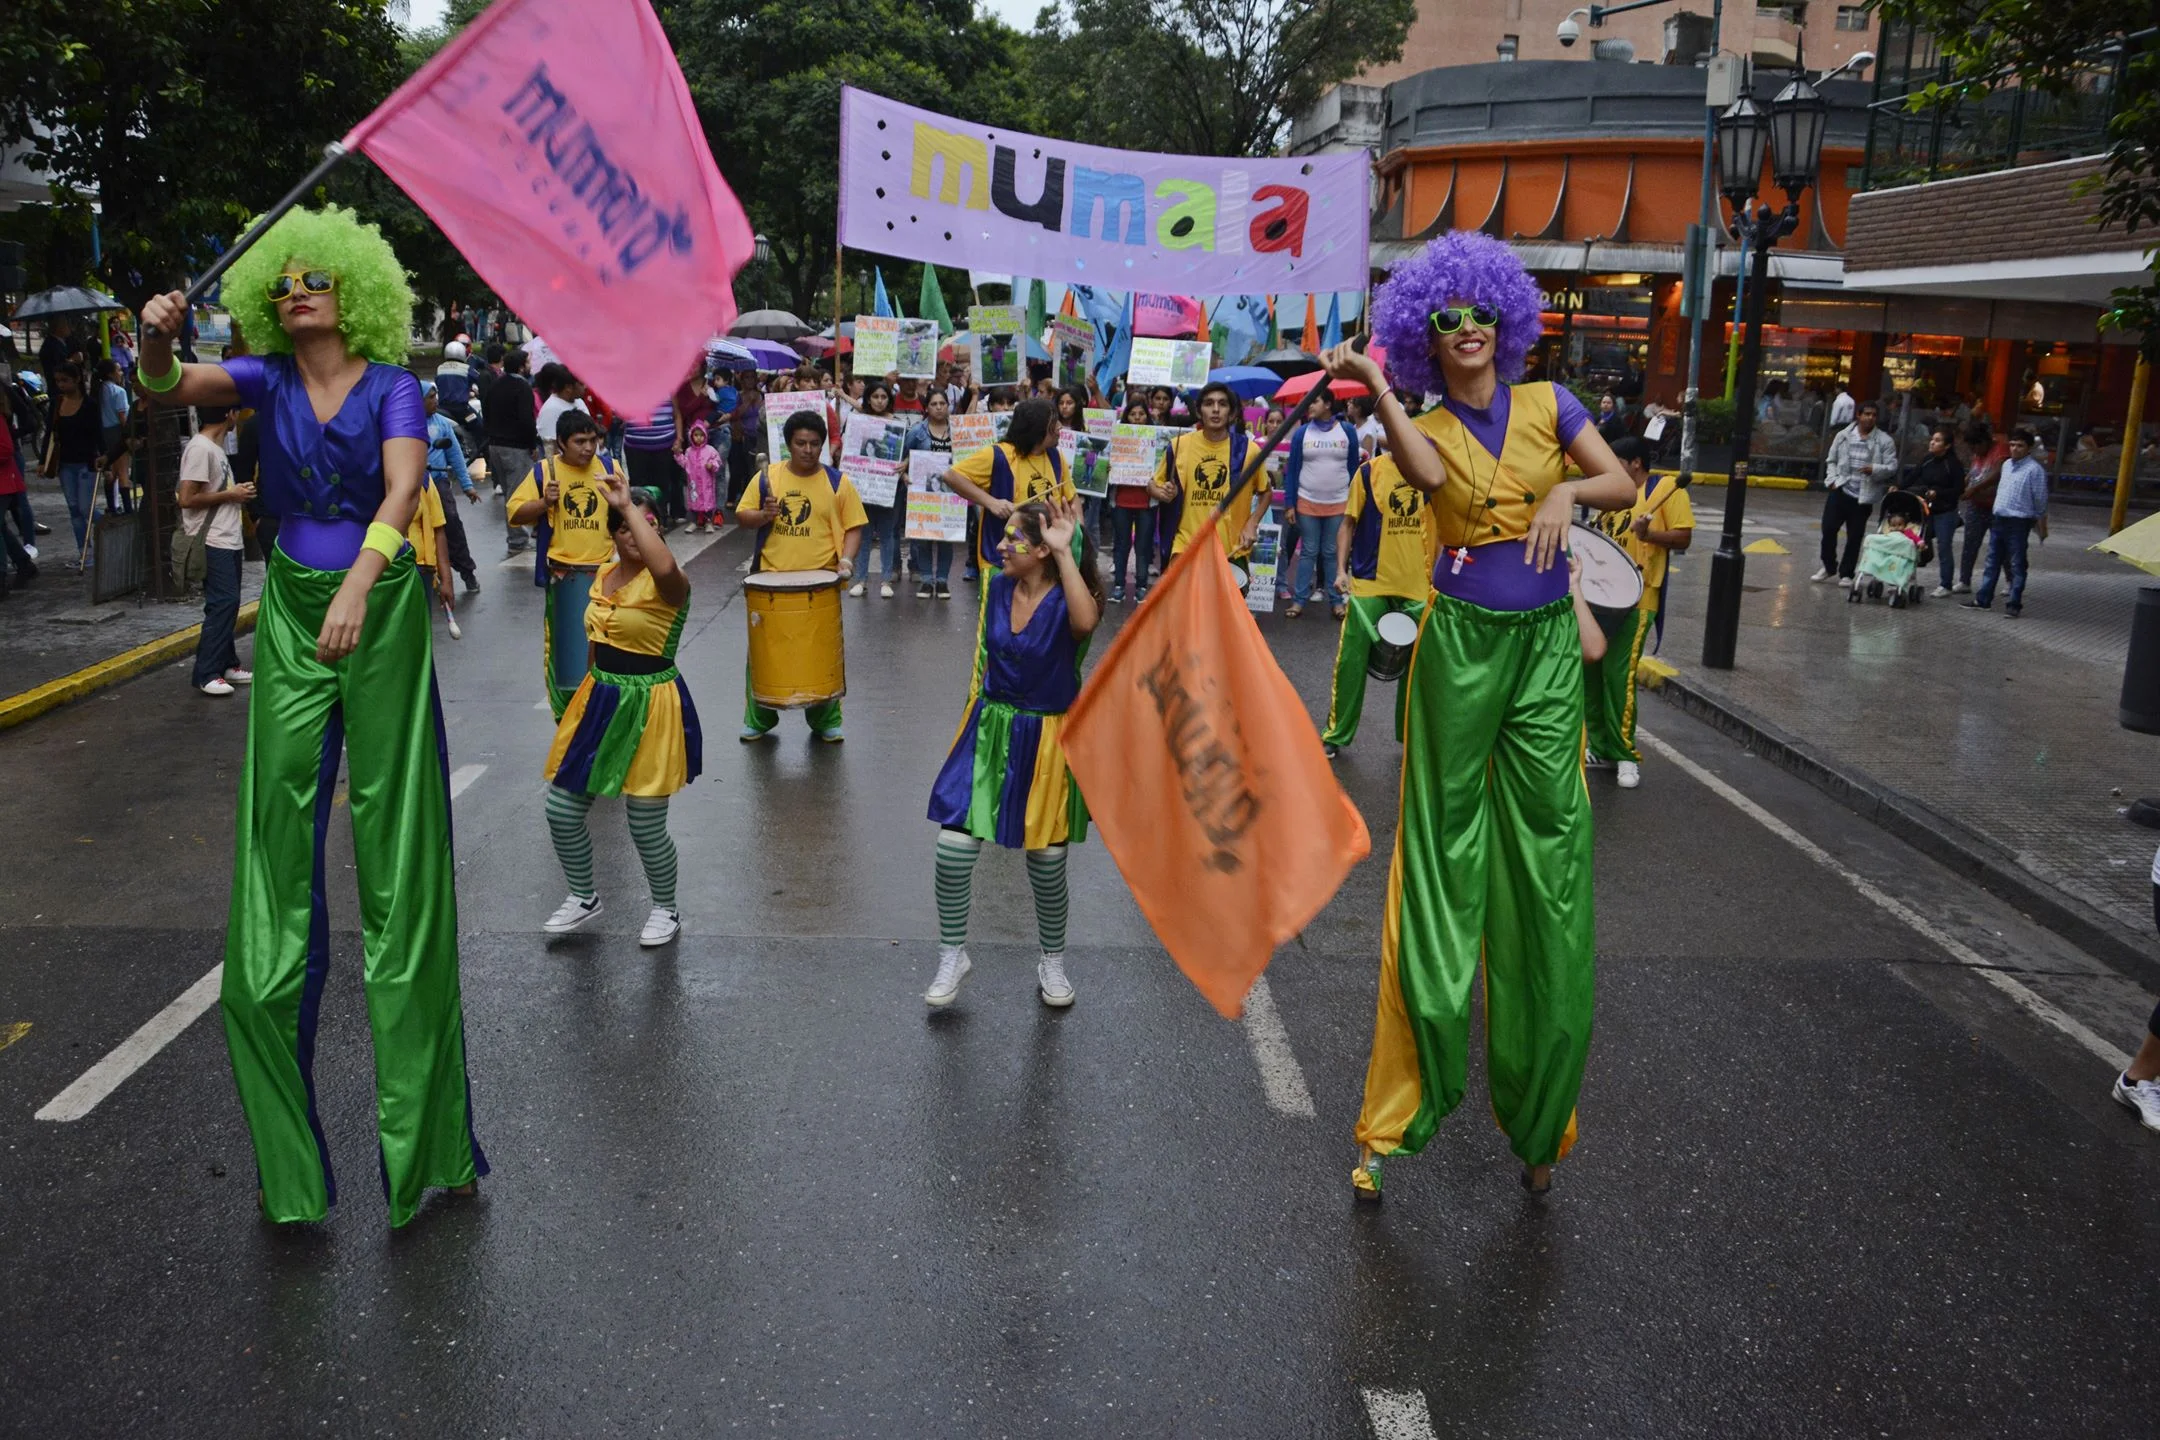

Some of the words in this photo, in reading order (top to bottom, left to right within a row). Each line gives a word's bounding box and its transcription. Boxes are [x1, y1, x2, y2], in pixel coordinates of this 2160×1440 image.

[909, 119, 1311, 258] mumala
[563, 519, 600, 531] HURACAN
[1388, 517, 1420, 528] HURACAN
[775, 523, 811, 537] HURACAN
